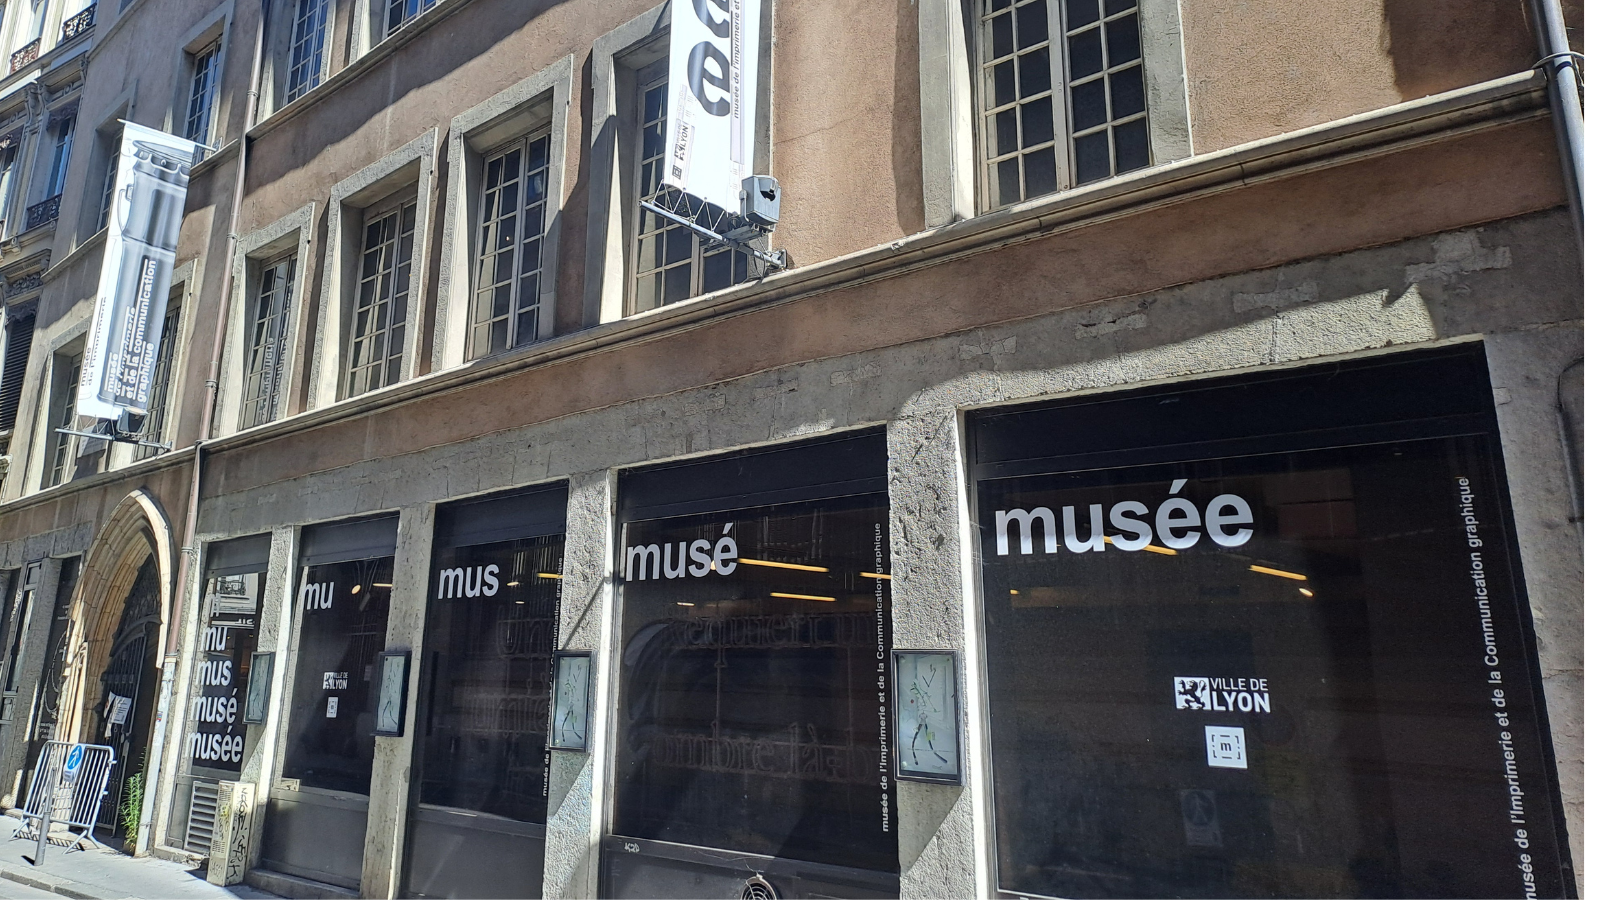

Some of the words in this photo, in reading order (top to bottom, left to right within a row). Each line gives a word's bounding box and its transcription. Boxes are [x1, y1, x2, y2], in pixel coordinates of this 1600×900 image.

[732, 12, 741, 70] l'imprimerie
[733, 72, 739, 84] de
[680, 125, 689, 148] LYON
[134, 260, 156, 354] communication
[128, 355, 140, 367] la
[137, 342, 154, 403] graphique
[128, 369, 137, 384] de
[126, 386, 135, 399] et
[995, 479, 1254, 556] musée
[1459, 477, 1483, 548] graphique
[625, 522, 738, 582] musé
[873, 523, 883, 574] graphique
[438, 564, 499, 600] mus
[299, 581, 335, 610] mu
[874, 577, 884, 660] Communication
[1470, 552, 1499, 666] Communication
[200, 625, 229, 651] mu
[195, 660, 233, 686] mus
[877, 662, 885, 672] la
[1488, 671, 1502, 684] la
[332, 679, 348, 690] LYON
[877, 675, 885, 689] de
[1210, 677, 1247, 691] VILLE
[1250, 678, 1268, 691] DE
[189, 687, 238, 724] musé
[878, 691, 885, 702] et
[1211, 691, 1271, 713] LYON
[1491, 689, 1506, 708] de
[1495, 712, 1509, 727] et
[184, 725, 243, 763] musée
[878, 705, 889, 772] l'Imprimerie
[544, 753, 550, 765] de
[880, 776, 888, 790] de
[1498, 731, 1525, 824] l'Imprimerie
[880, 793, 889, 832] musée
[1514, 829, 1529, 849] de
